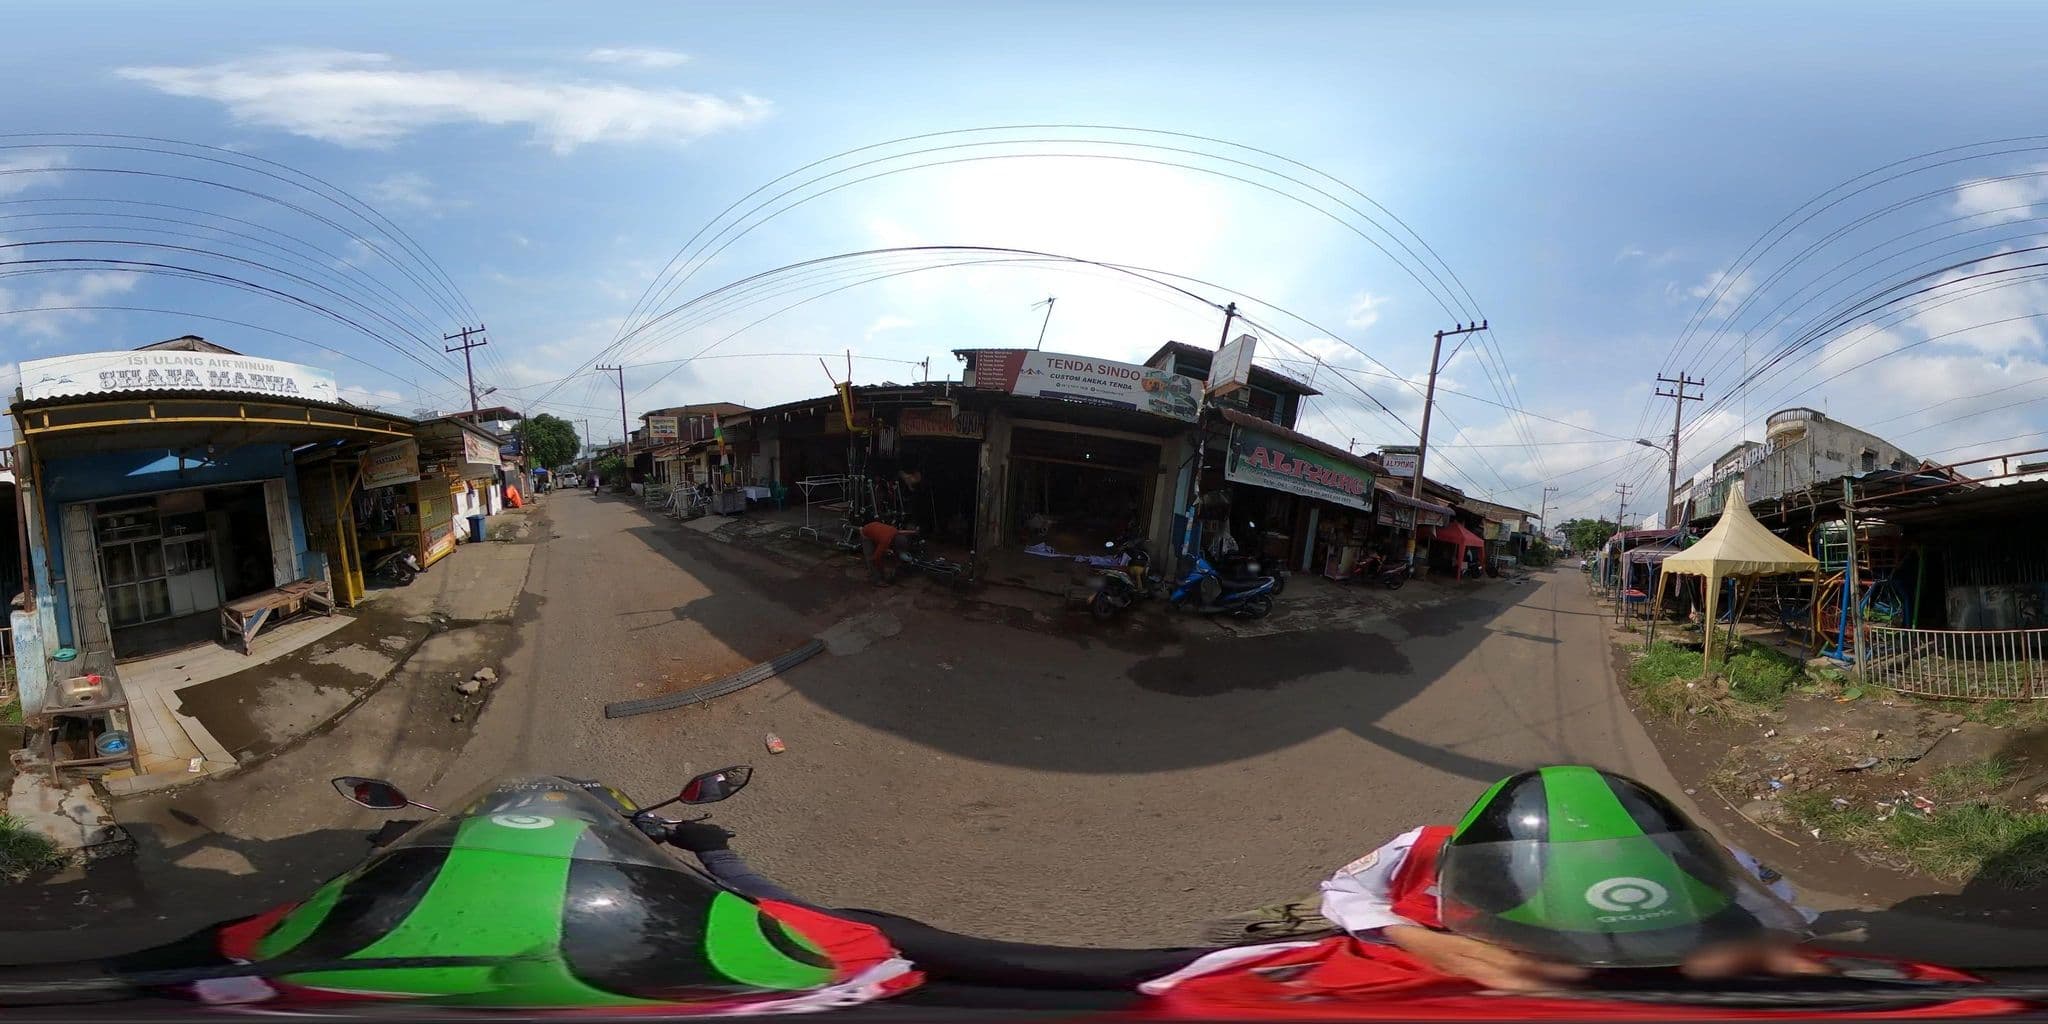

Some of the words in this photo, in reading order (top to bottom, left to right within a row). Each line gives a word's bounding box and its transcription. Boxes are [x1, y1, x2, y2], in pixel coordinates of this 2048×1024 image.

[128, 356, 148, 365] ISI
[153, 356, 204, 366] ULANG
[208, 358, 230, 367] AIR
[233, 360, 275, 373] MINUM
[1046, 358, 1093, 373] TENDA
[1097, 364, 1141, 381] SINDO
[1050, 373, 1081, 382] CUSTOM
[1082, 377, 1107, 386] ANEKA
[1109, 381, 1133, 390] TENDA
